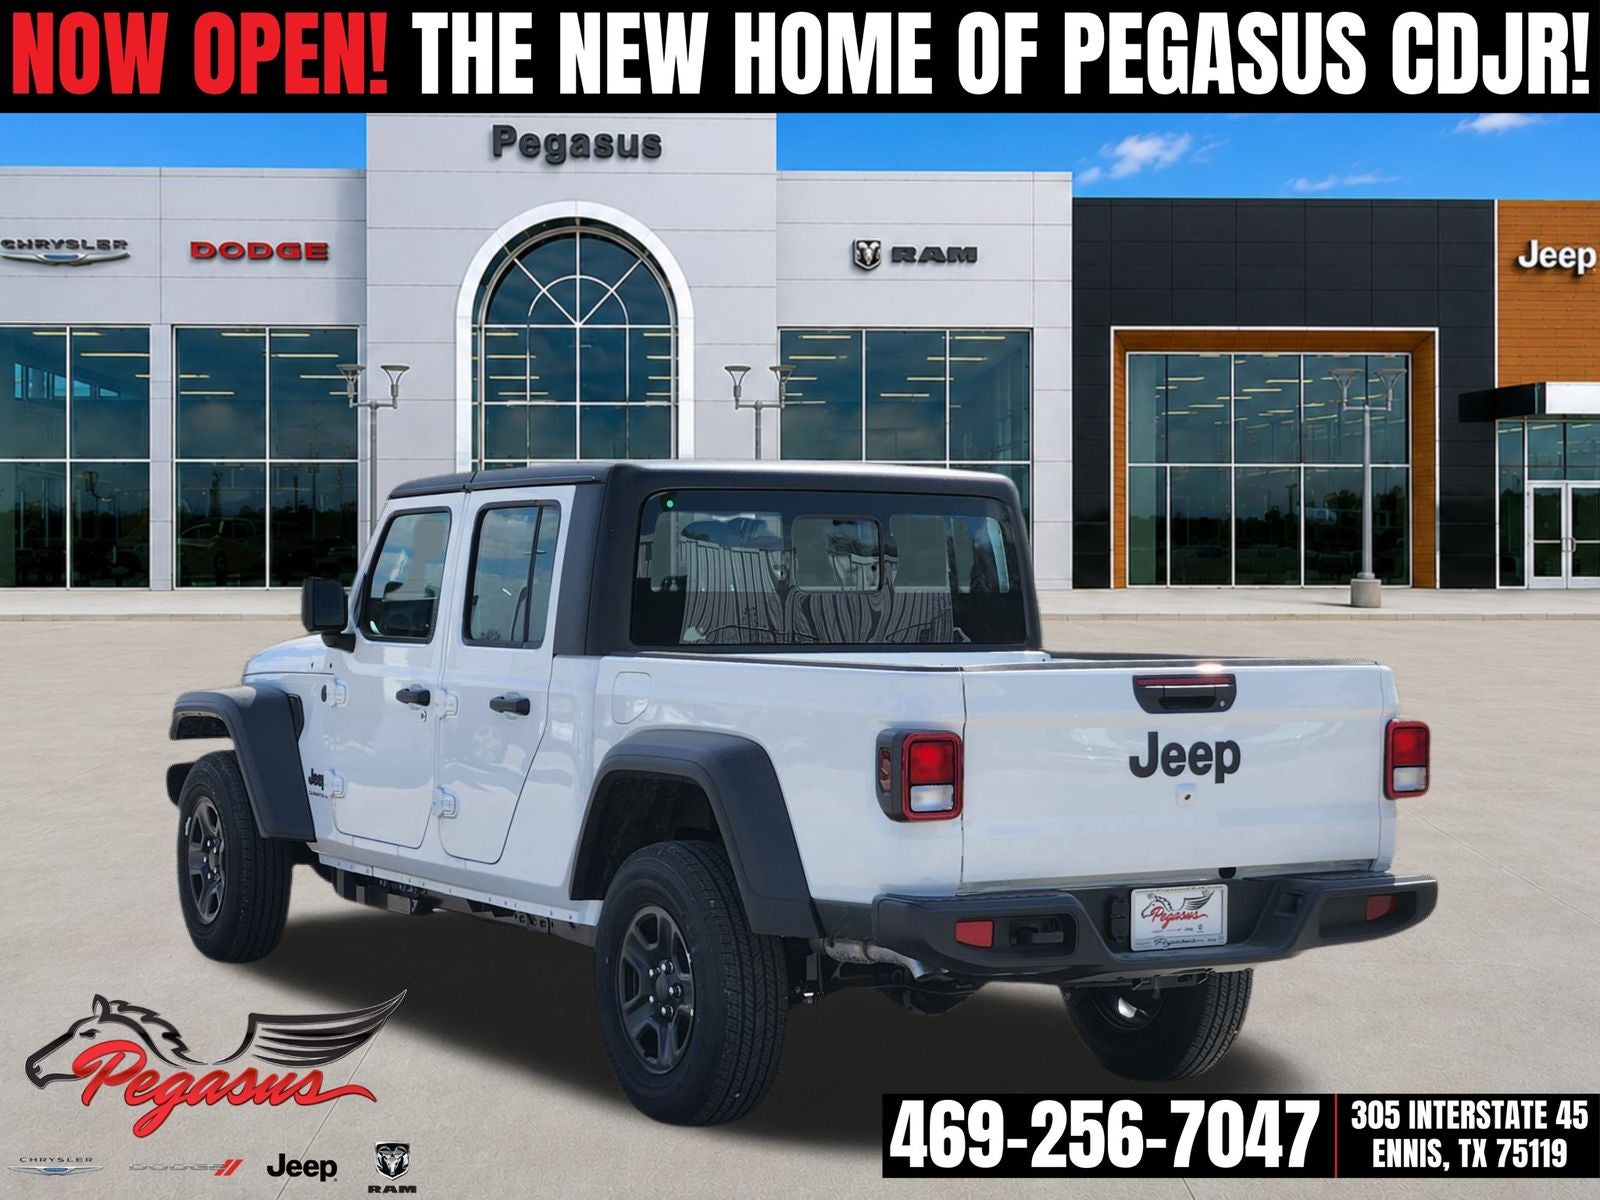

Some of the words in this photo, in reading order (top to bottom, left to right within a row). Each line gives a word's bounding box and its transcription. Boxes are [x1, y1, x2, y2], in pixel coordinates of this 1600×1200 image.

[491, 123, 663, 166] Pegasus
[0, 238, 128, 251] CHRYSLER
[190, 240, 329, 261] DODGE
[891, 246, 978, 264] RAM
[1517, 239, 1597, 275] Jeep
[1129, 731, 1241, 784] Jeep
[1150, 905, 1208, 930] Pegasus
